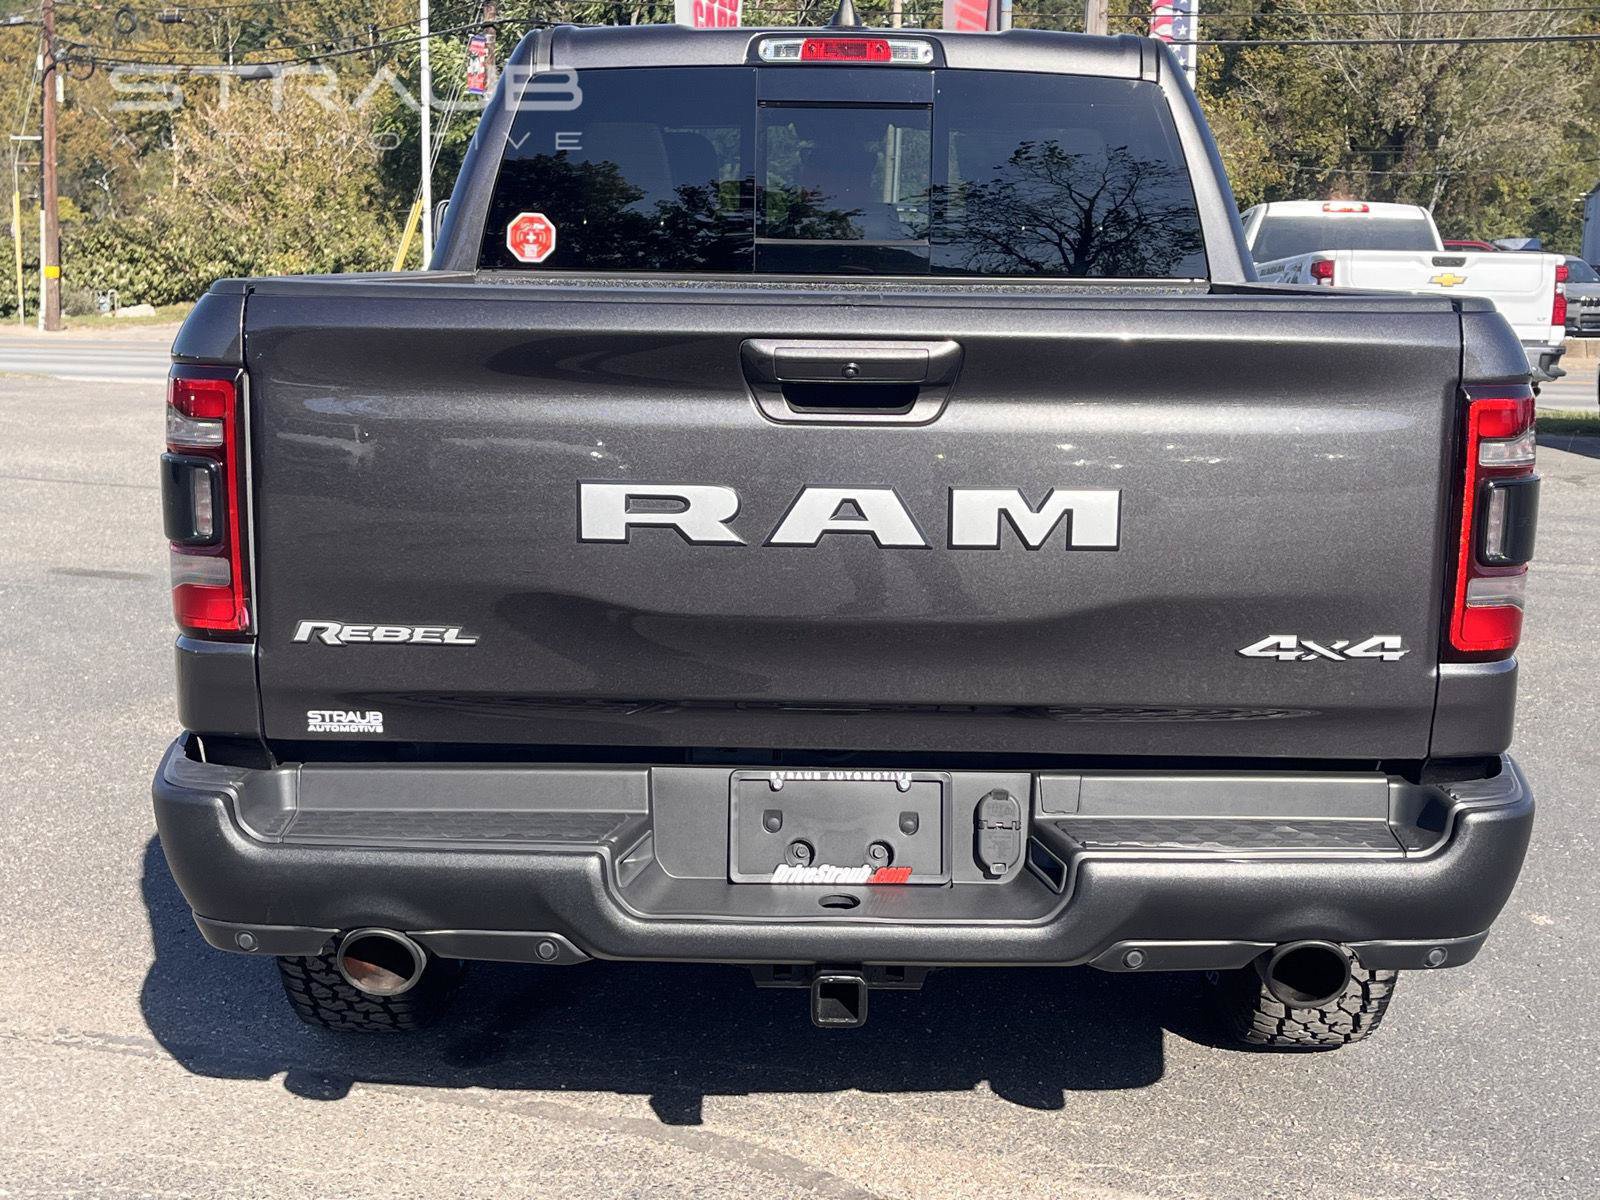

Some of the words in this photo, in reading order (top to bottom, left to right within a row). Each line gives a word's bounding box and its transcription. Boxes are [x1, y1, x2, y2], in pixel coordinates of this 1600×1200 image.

[576, 480, 1122, 552] RAM
[291, 619, 479, 646] REBEL
[307, 710, 383, 723] STRAUB
[307, 724, 384, 733] AUTOMOTIVE
